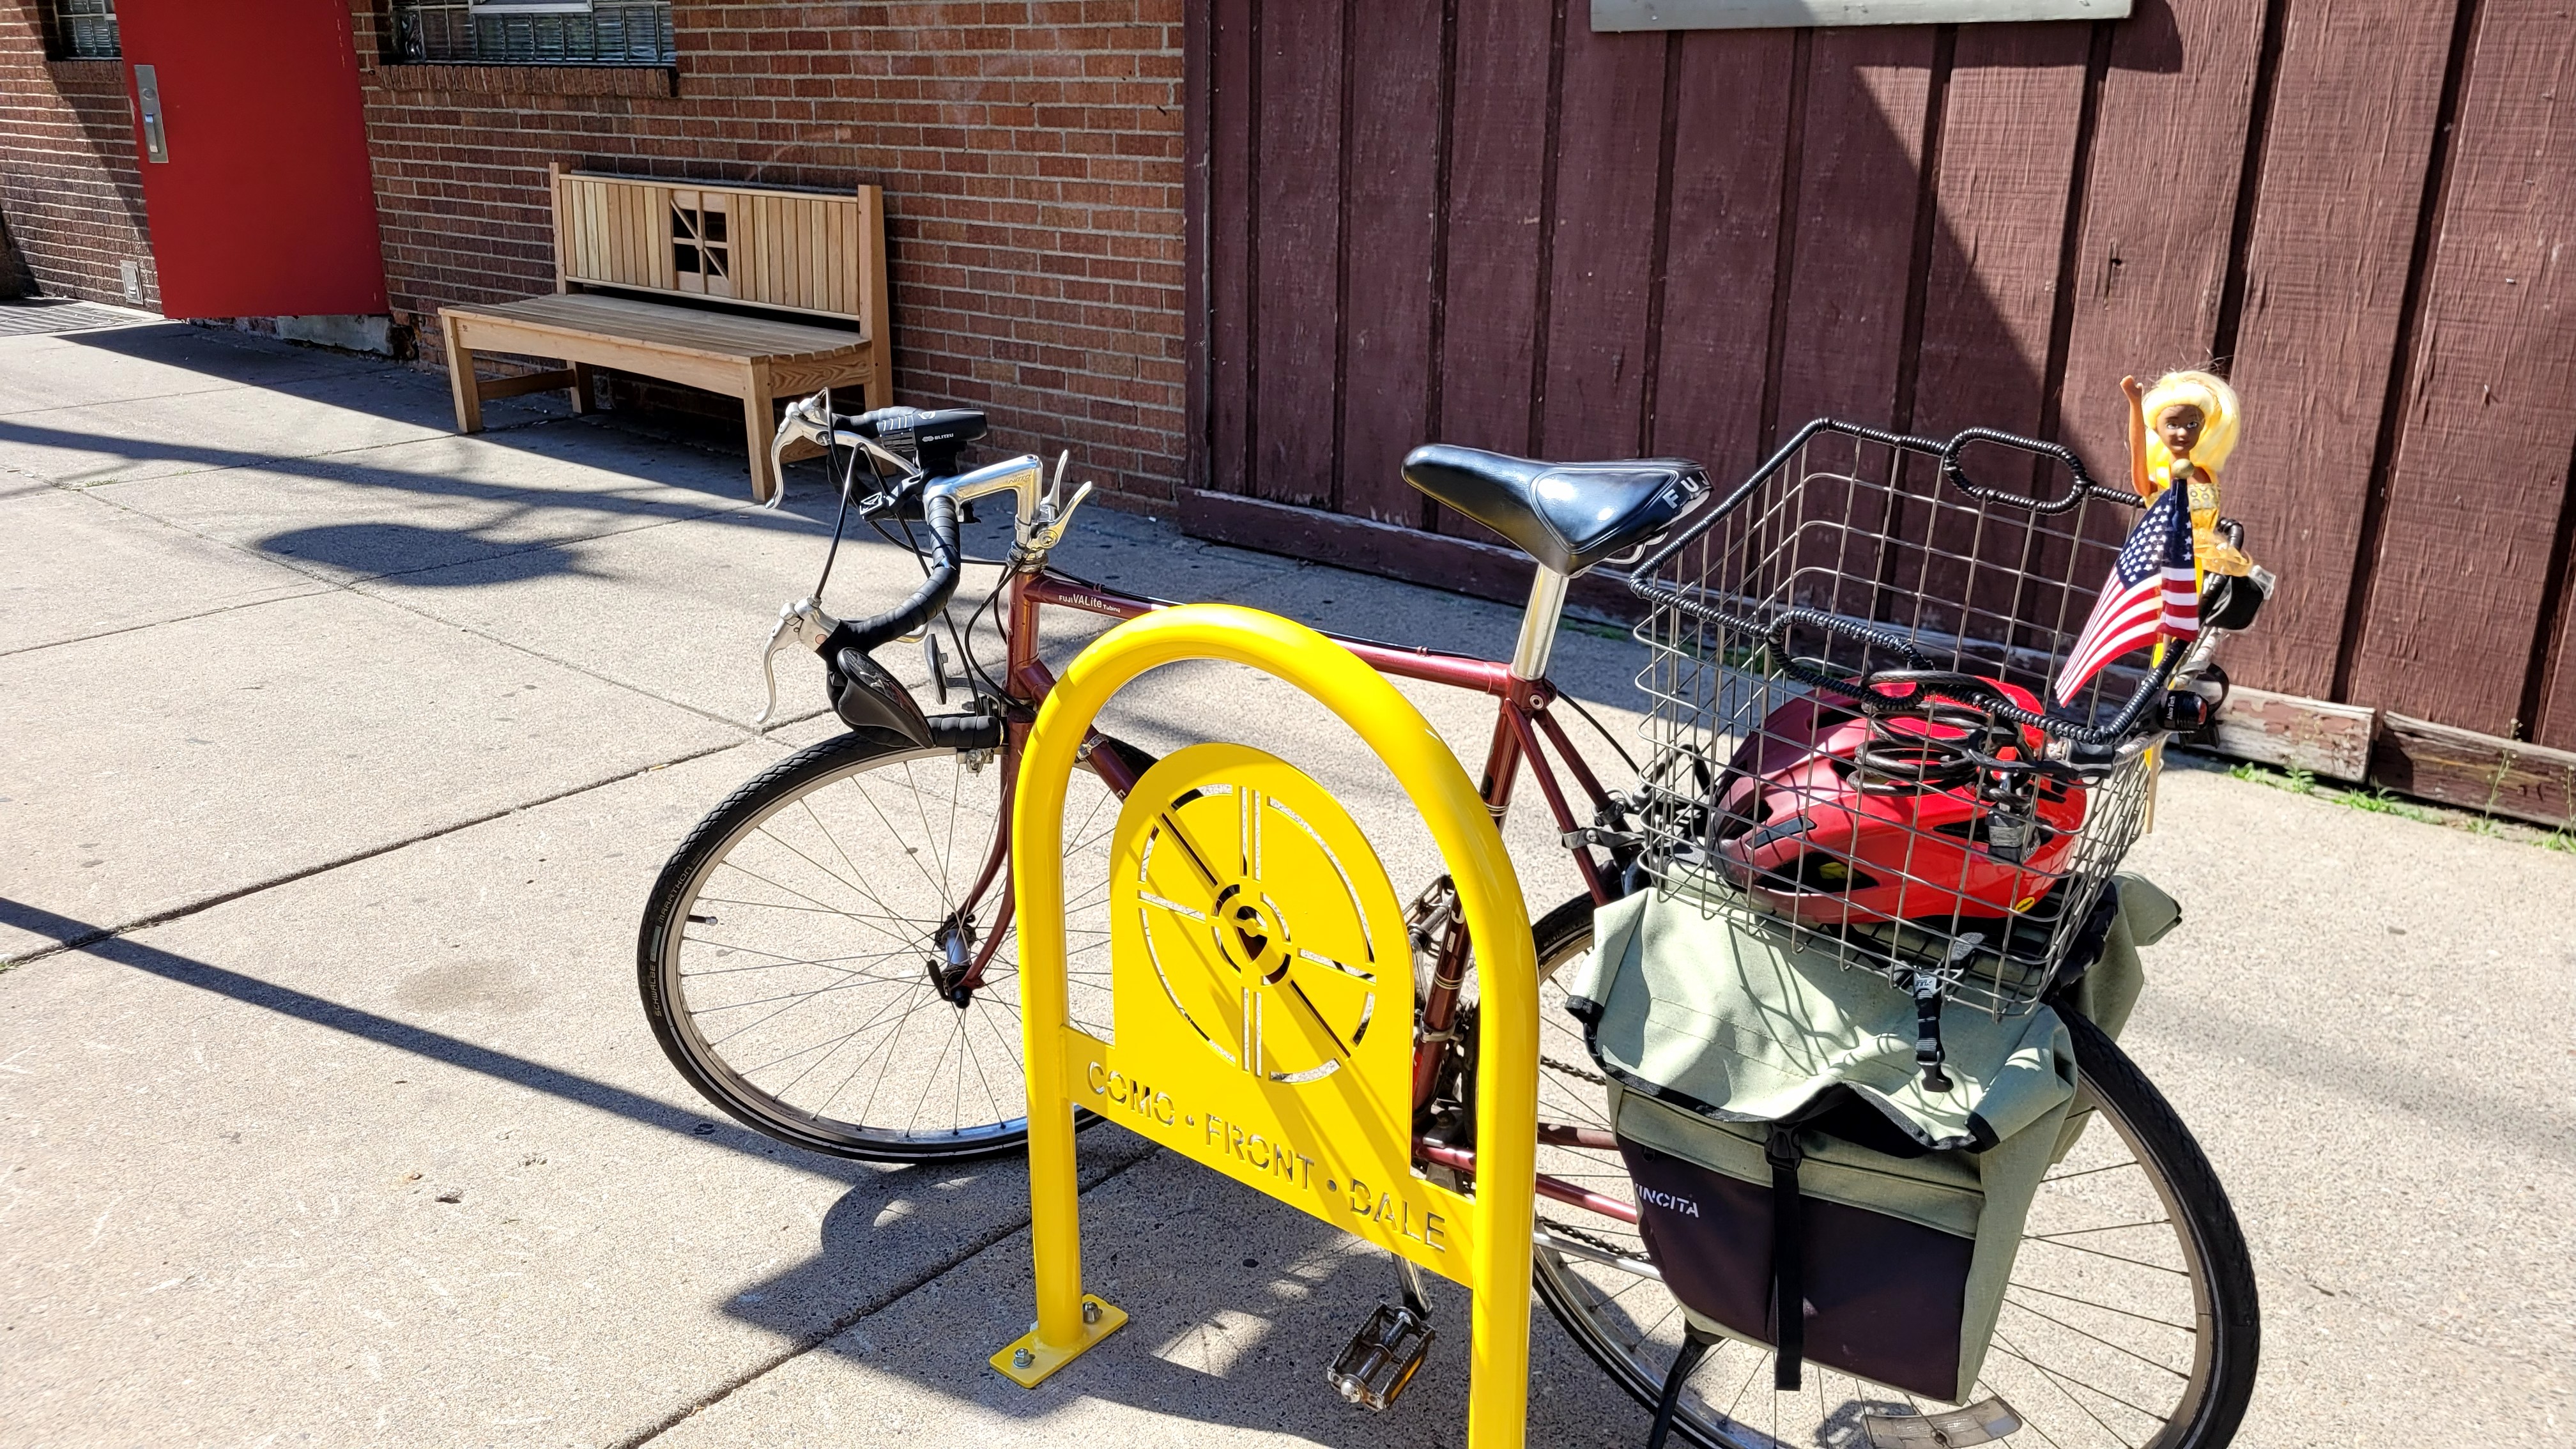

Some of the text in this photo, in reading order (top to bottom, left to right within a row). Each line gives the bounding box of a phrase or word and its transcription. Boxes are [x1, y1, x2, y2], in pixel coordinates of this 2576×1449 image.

[1009, 475, 1031, 484] NITTO
[650, 866, 693, 1017] SCHWALBE MARATHON
[1088, 1061, 1446, 1254] COMO FRONT DALE
